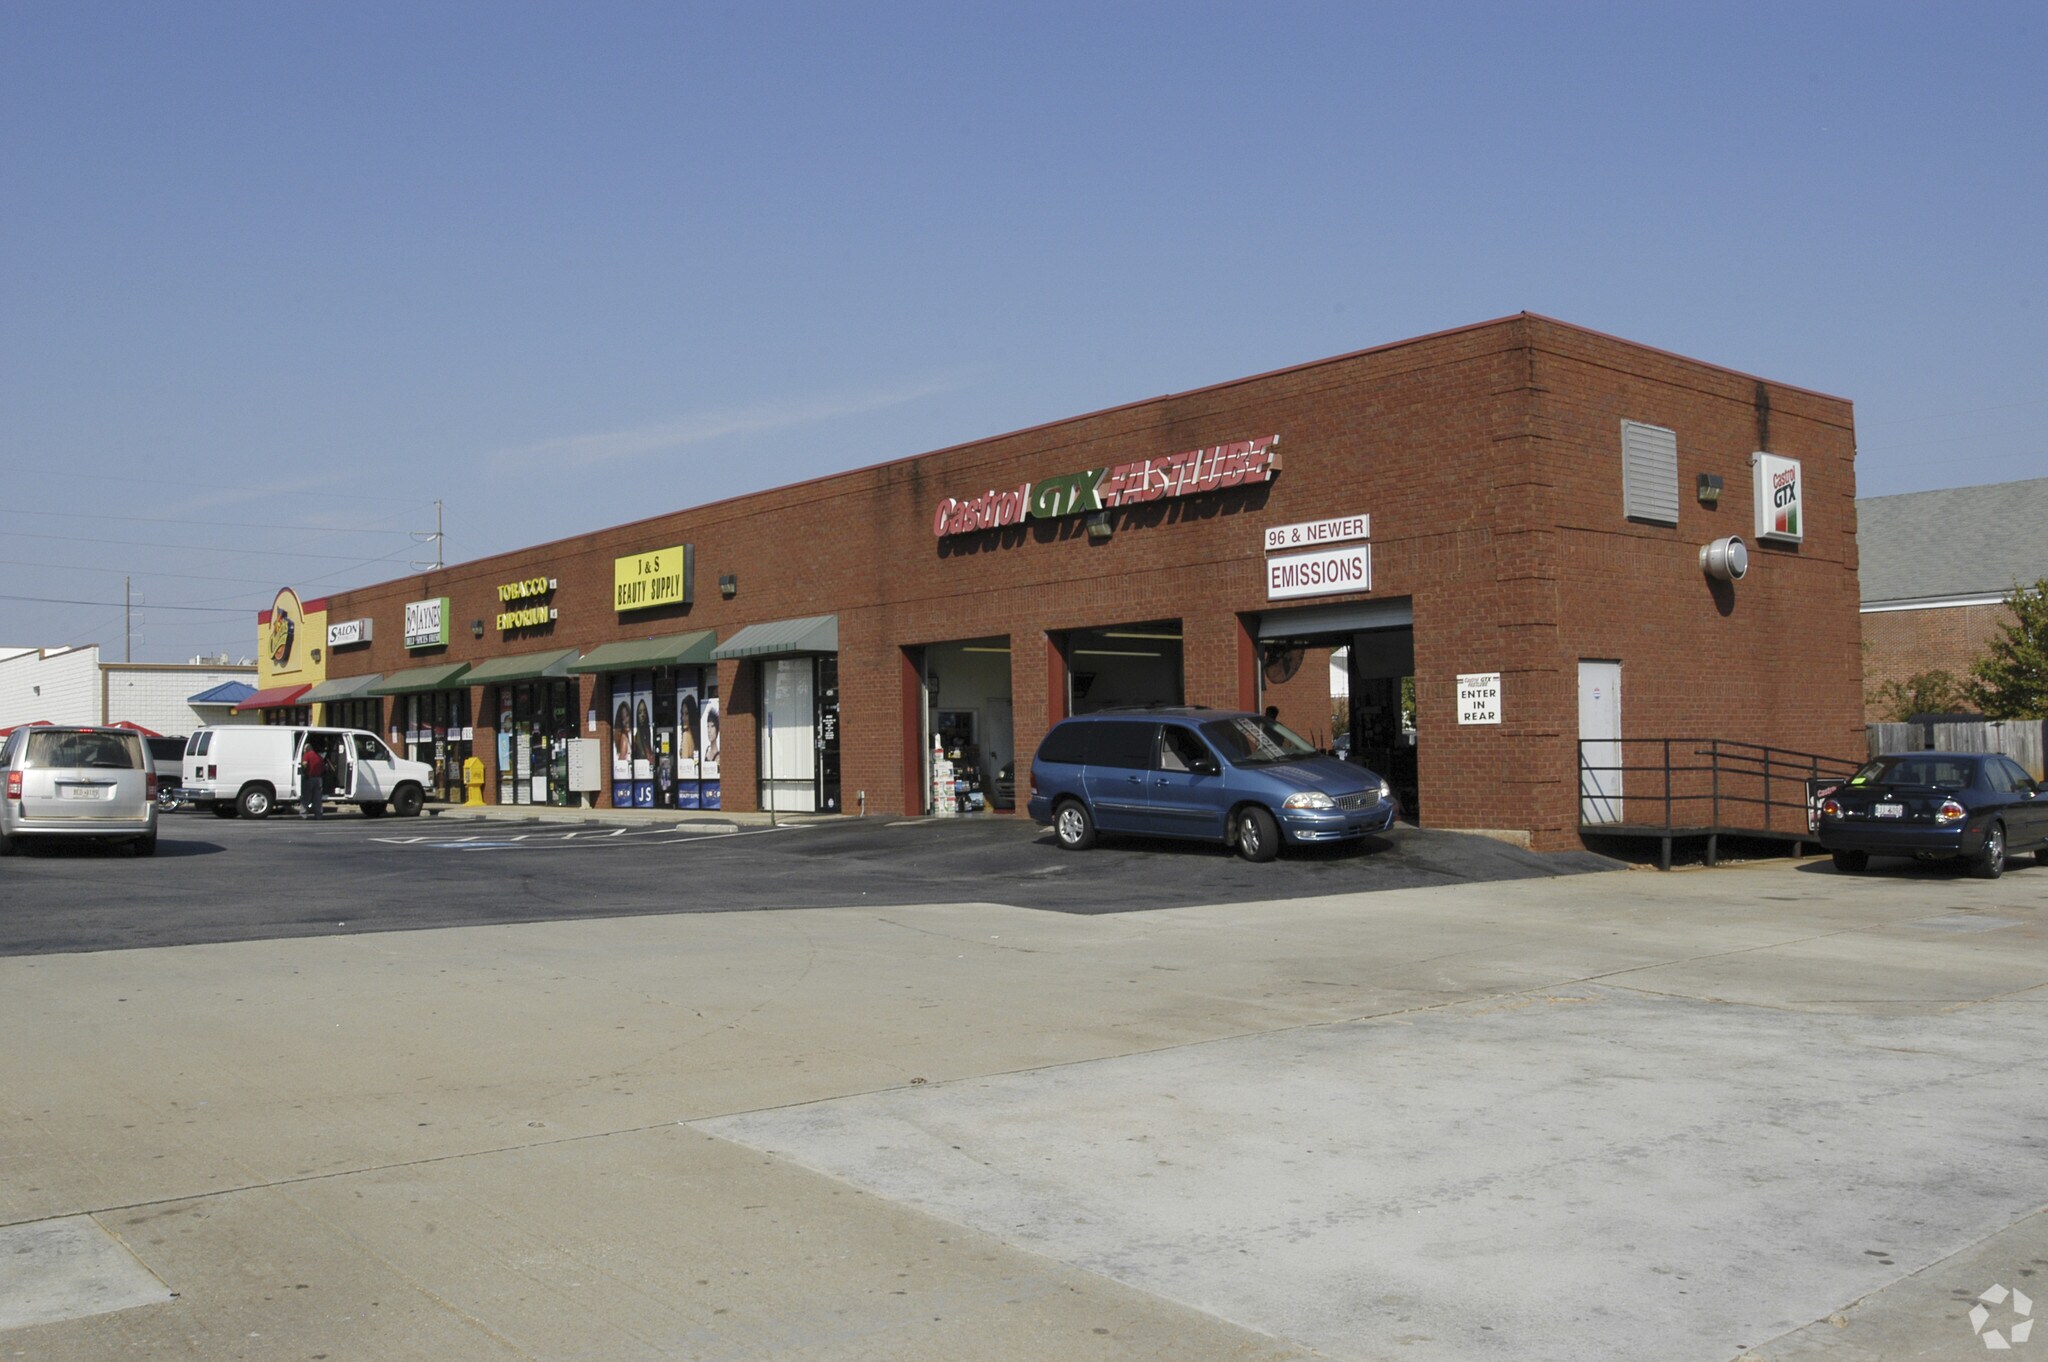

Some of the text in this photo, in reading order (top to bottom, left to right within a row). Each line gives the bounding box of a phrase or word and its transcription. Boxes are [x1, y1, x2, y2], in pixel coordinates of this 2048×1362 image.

[1773, 465, 1796, 489] Castrol
[933, 483, 1031, 537] Castrol
[1030, 467, 1109, 519] GTX
[1774, 481, 1796, 508] GTX
[1269, 519, 1364, 546] 96 & NEWER
[638, 556, 660, 576] J & S
[1272, 557, 1363, 589] EMISSIONS
[497, 576, 548, 602] TOBACCO
[618, 574, 680, 605] BEAUTY SUPPLY
[496, 606, 549, 631] EMPORIUM
[330, 624, 359, 643] SALON
[1461, 689, 1496, 699] ENTER
[1473, 701, 1485, 709] IN
[1464, 712, 1495, 721] REAR
